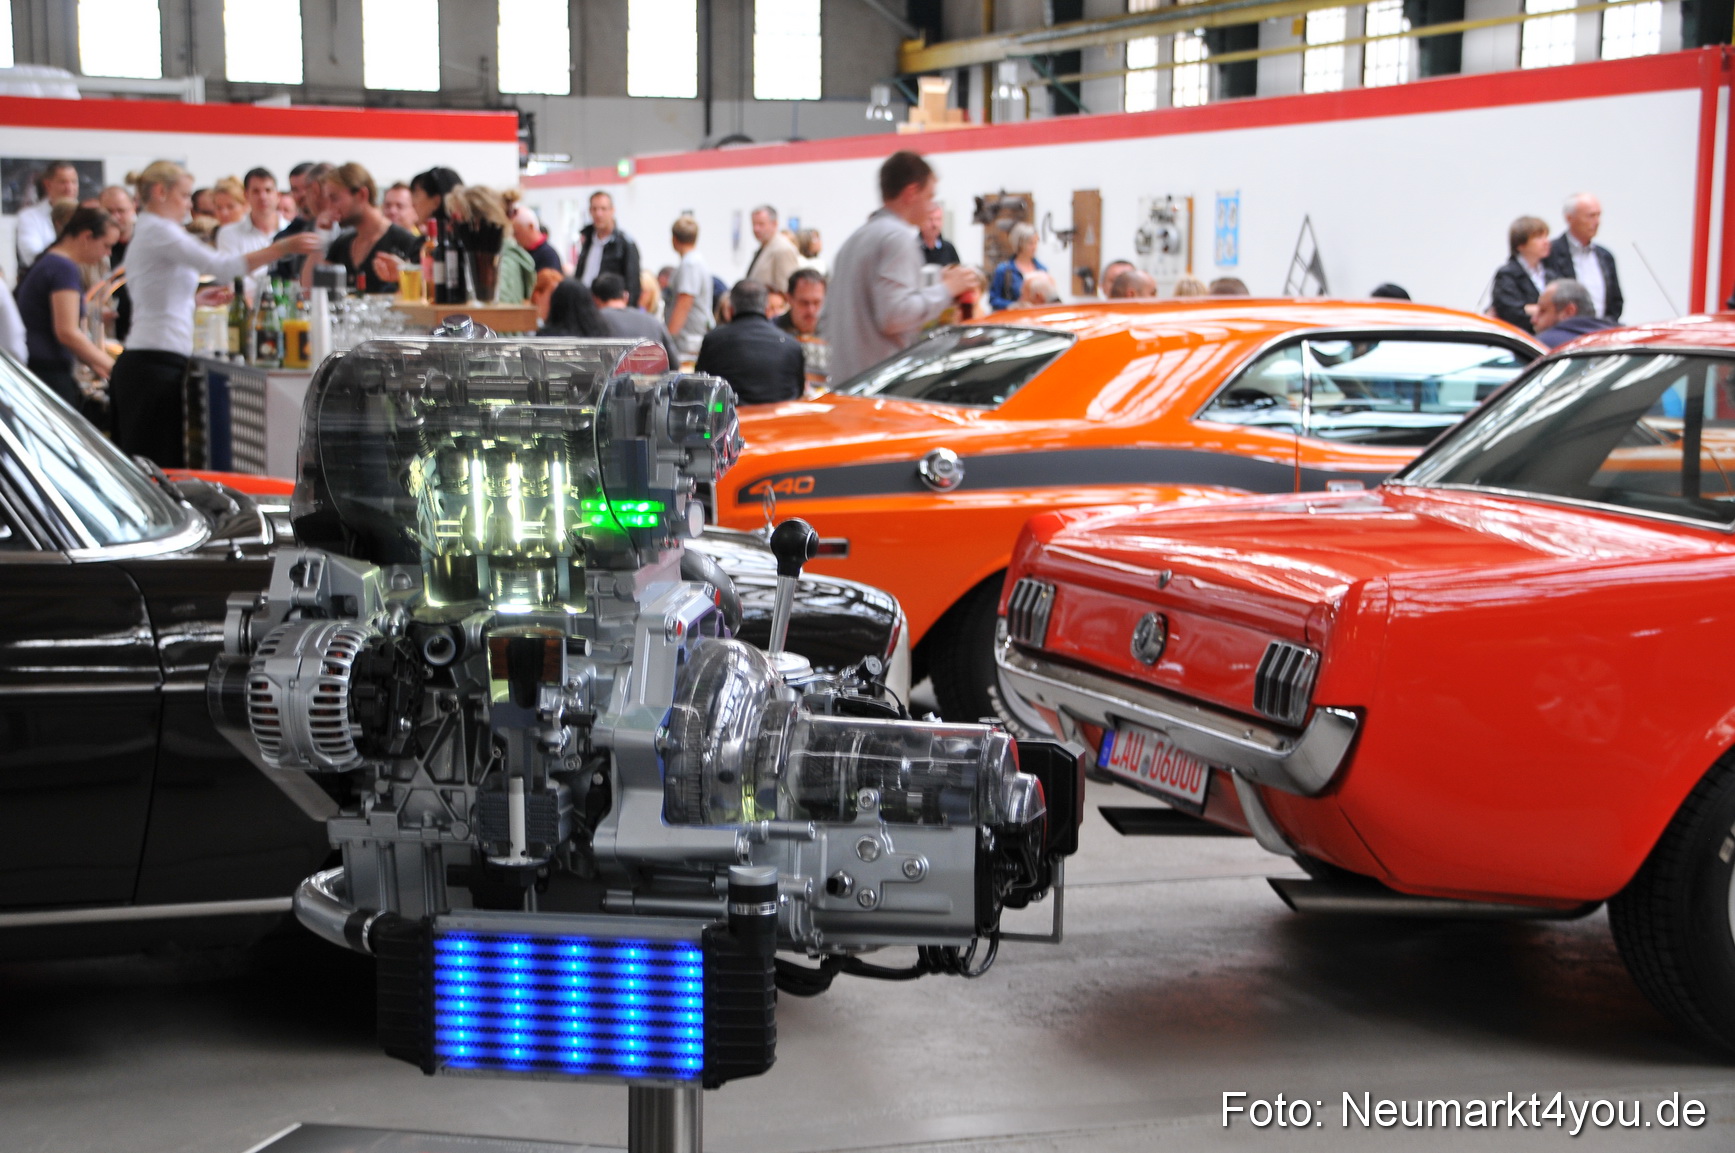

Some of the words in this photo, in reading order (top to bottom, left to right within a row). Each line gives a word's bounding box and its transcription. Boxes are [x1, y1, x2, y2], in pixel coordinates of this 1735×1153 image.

[748, 475, 816, 495] 440
[1110, 730, 1146, 772] LAU
[1149, 740, 1203, 794] 06000
